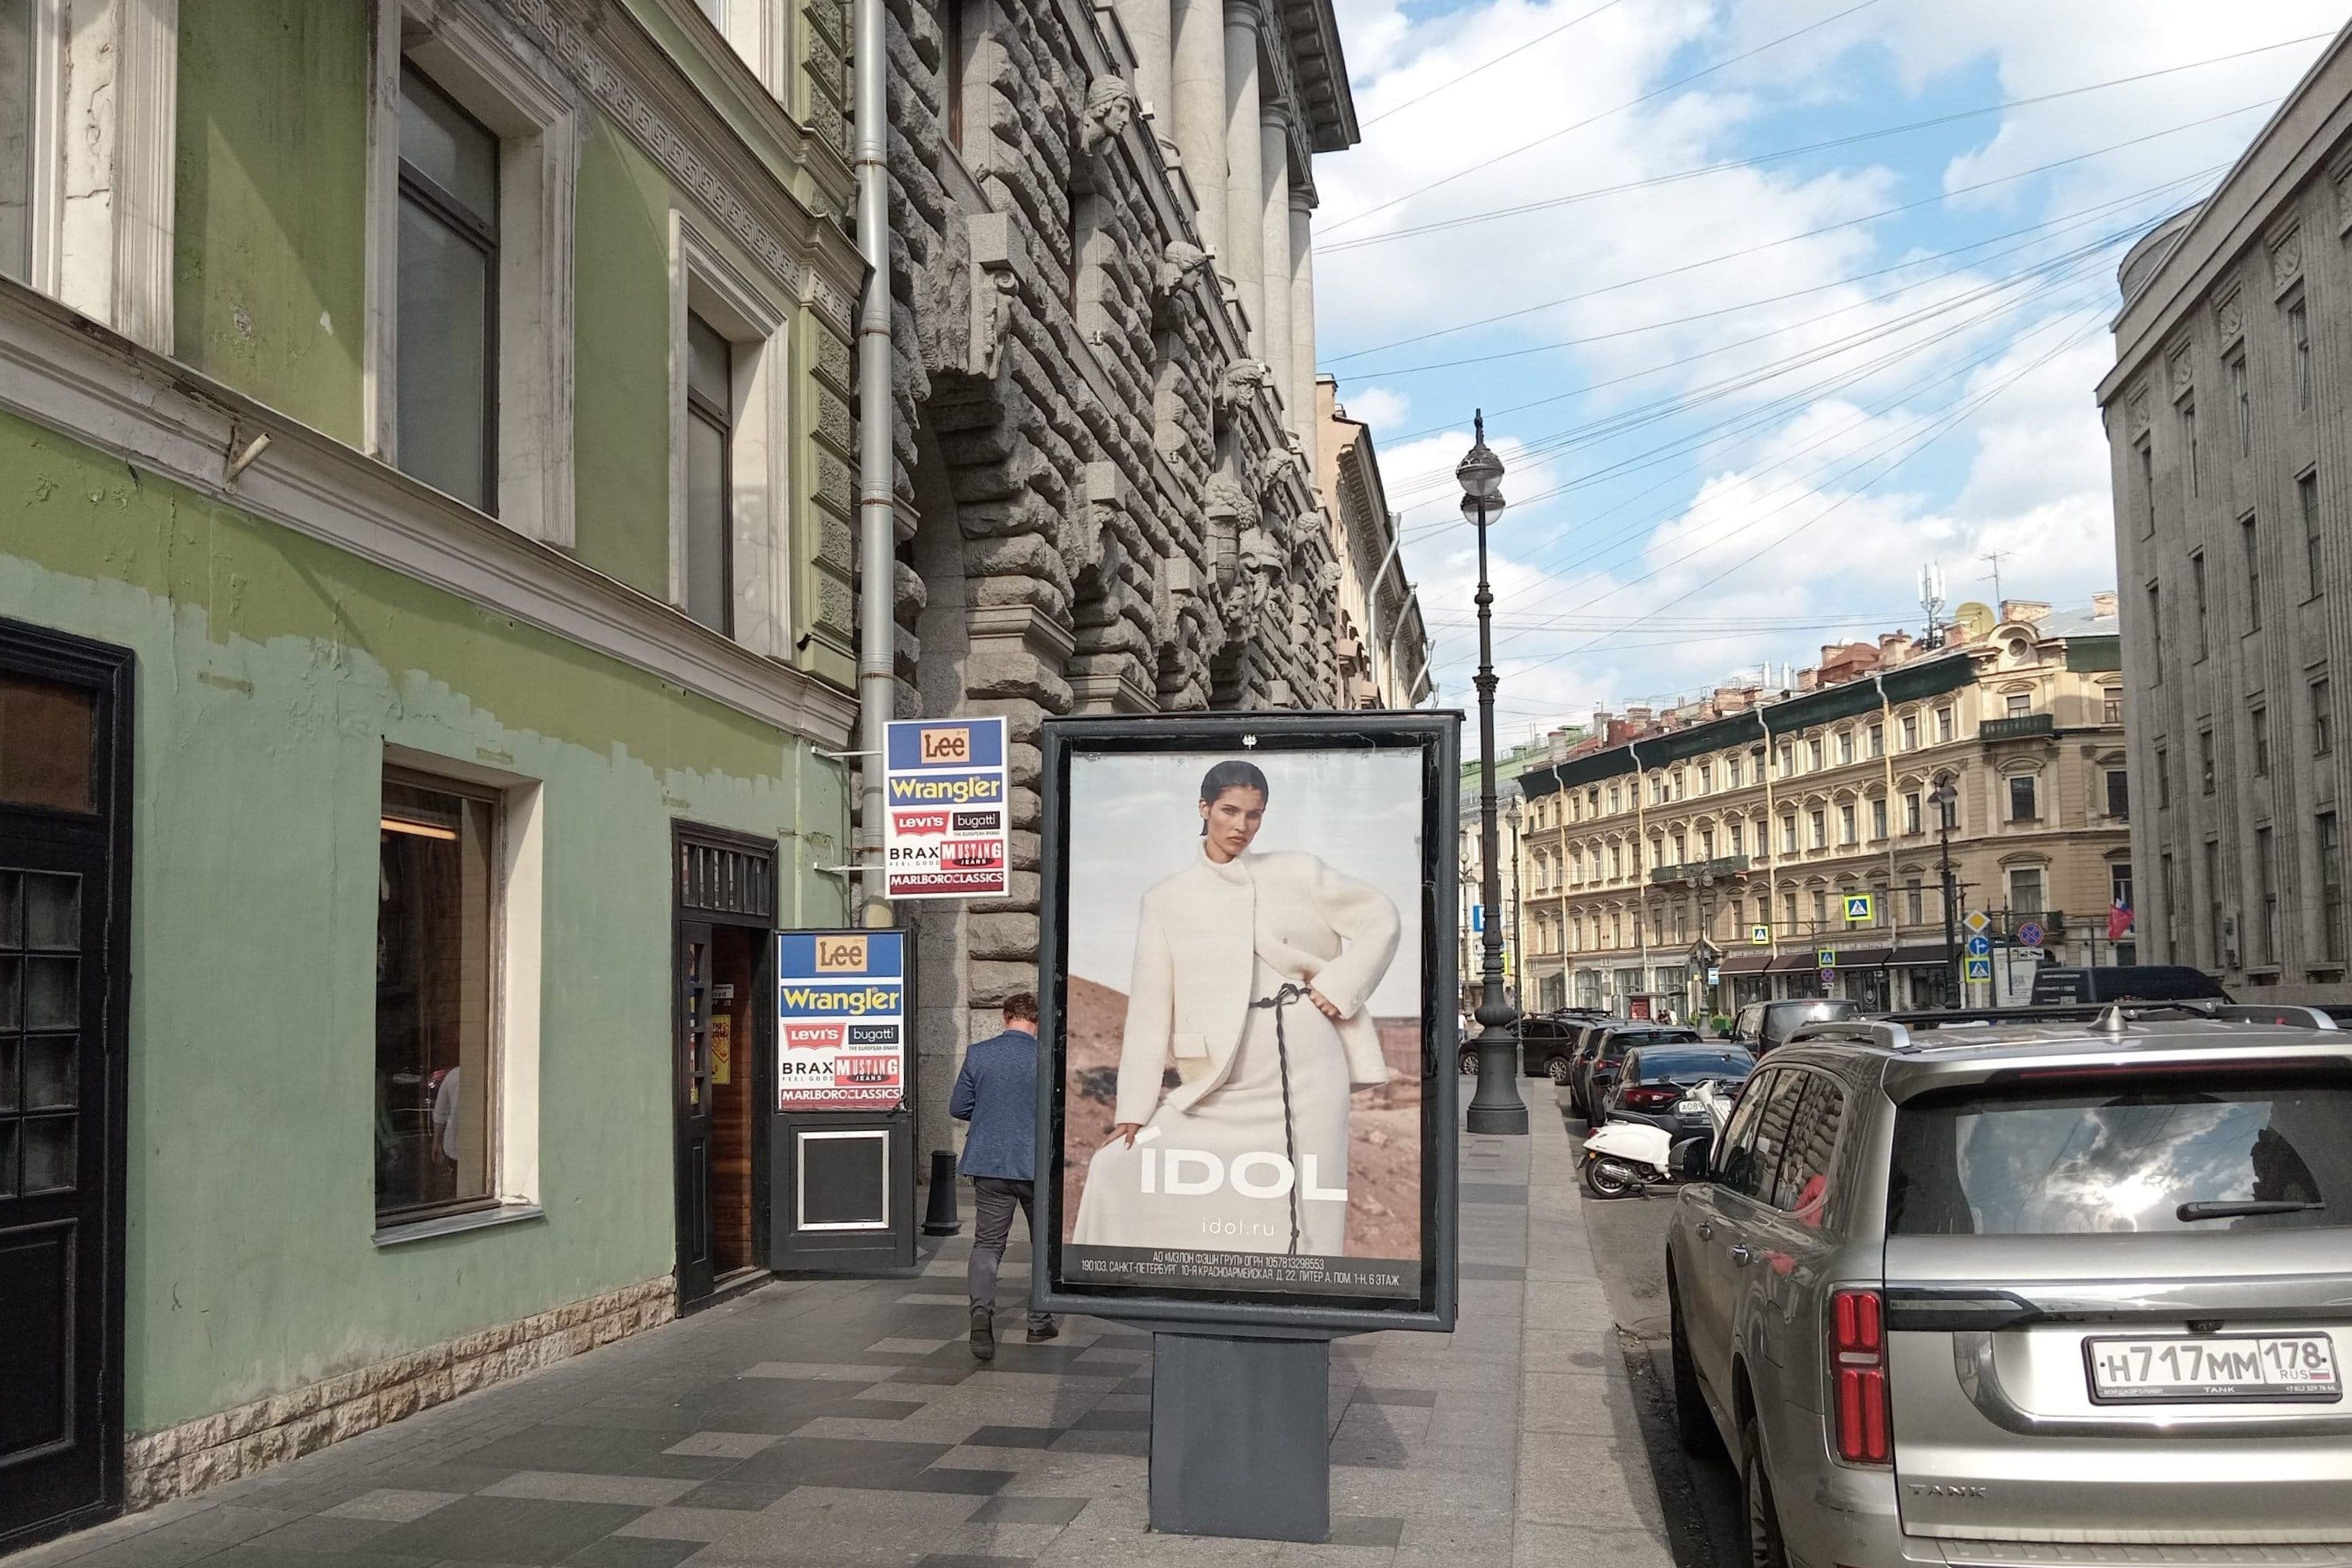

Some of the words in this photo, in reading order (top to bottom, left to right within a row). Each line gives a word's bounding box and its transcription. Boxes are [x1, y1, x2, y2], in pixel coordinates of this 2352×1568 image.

[924, 734, 965, 758] Lee
[890, 777, 1001, 803] Wrangler
[958, 814, 996, 828] bugatti
[890, 847, 939, 860] BRAX
[942, 842, 1002, 860] MUSTANG
[820, 942, 862, 966] Lee
[783, 987, 899, 1015] Wrangler
[854, 1027, 893, 1042] bugatti
[782, 1062, 834, 1074] BRAX
[836, 1058, 898, 1075] MUSTANG
[1202, 1218, 1274, 1236] idol.ru
[1152, 1251, 1163, 1263] АО
[1165, 1252, 1194, 1264] «МЭЛОН
[1195, 1254, 1219, 1266] ФЭШН
[1220, 1254, 1243, 1266] ГРУП»
[1244, 1256, 1263, 1267] ОГРН
[1266, 1257, 1324, 1270] 1057813298553
[1181, 1264, 1198, 1276] 10-Я
[1298, 1270, 1323, 1282] ЛИТЕР
[1369, 1274, 1374, 1285] 6
[1375, 1274, 1400, 1286] ЭТАЖ
[2264, 1342, 2322, 1370] 178
[2280, 1370, 2309, 1379] RUS
[1907, 1484, 1986, 1498] TANK
